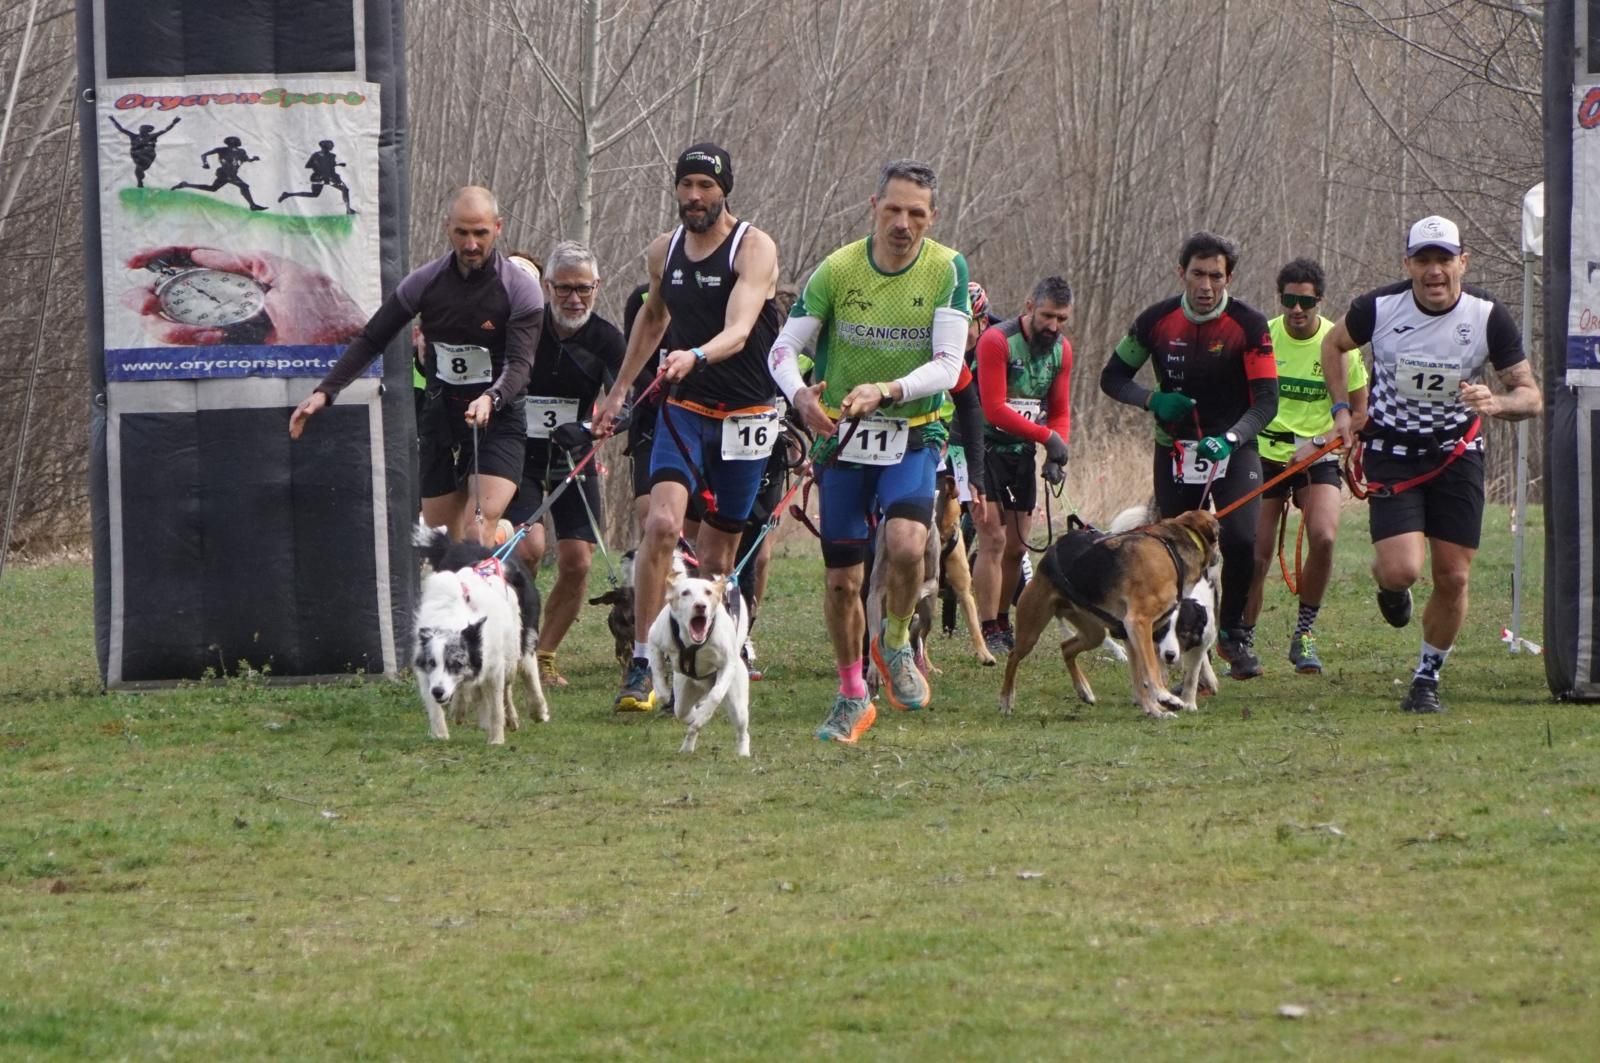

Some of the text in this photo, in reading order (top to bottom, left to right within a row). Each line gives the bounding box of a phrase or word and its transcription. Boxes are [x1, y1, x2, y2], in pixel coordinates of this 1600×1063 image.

[122, 356, 340, 373] www.orycronsport.c
[451, 357, 468, 374] 8
[1412, 372, 1445, 391] 12
[543, 410, 557, 428] 3
[739, 426, 767, 447] 16
[856, 429, 888, 452] 11
[1194, 454, 1209, 472] 5
